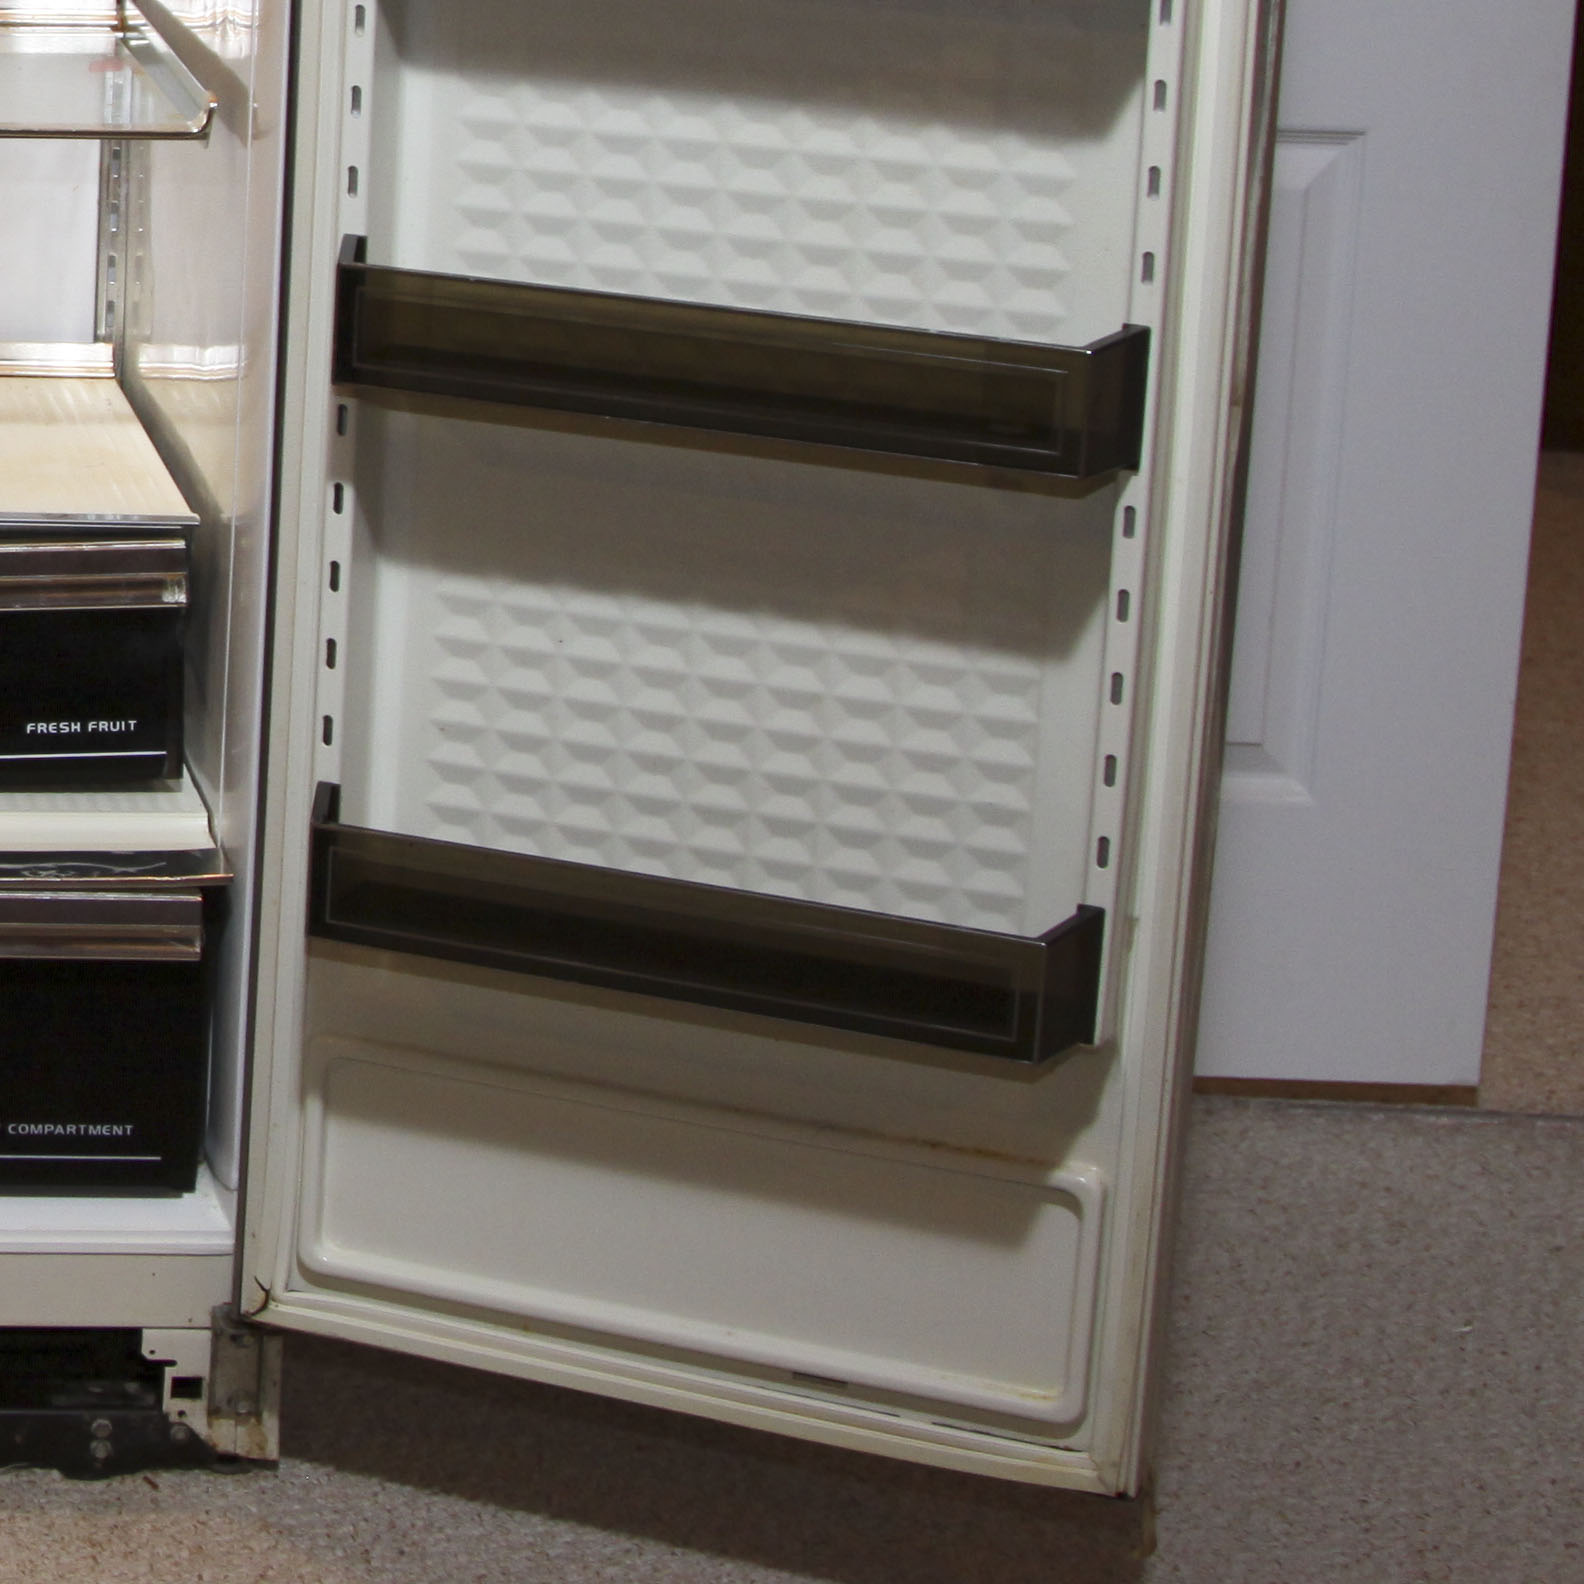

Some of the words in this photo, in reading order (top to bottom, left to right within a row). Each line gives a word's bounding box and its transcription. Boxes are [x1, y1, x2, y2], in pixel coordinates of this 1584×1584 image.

[26, 720, 81, 735] FRESH
[87, 719, 138, 734] FRUIT
[7, 1122, 135, 1136] COMPARTMENT
